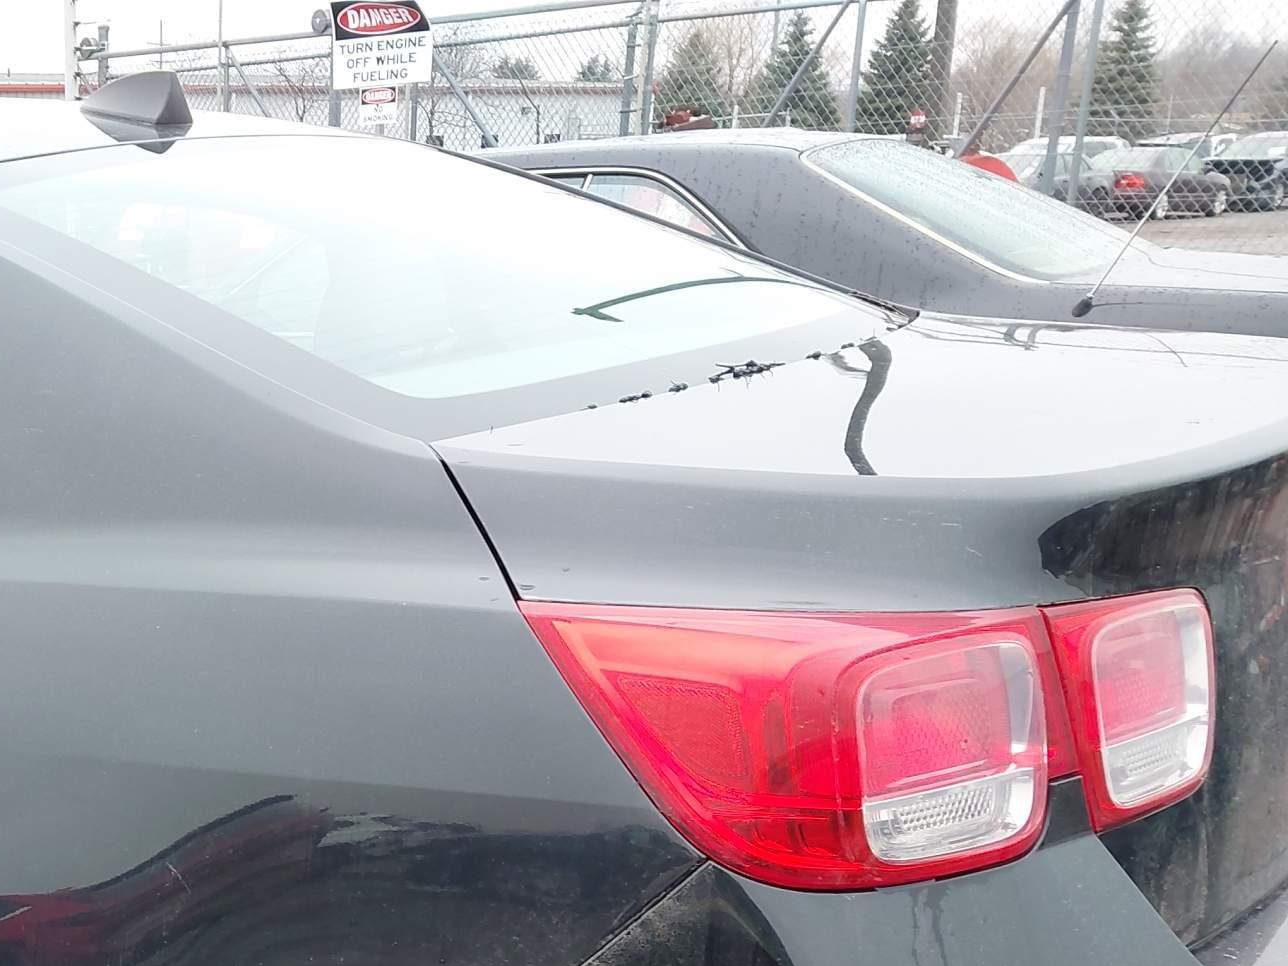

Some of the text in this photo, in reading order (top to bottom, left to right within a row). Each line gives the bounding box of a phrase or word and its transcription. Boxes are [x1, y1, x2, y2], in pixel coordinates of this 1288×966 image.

[347, 8, 413, 29] DANGER
[340, 37, 426, 55] TURN ENGINE
[347, 54, 416, 69] OFF WHILE
[353, 69, 408, 82] FUELING
